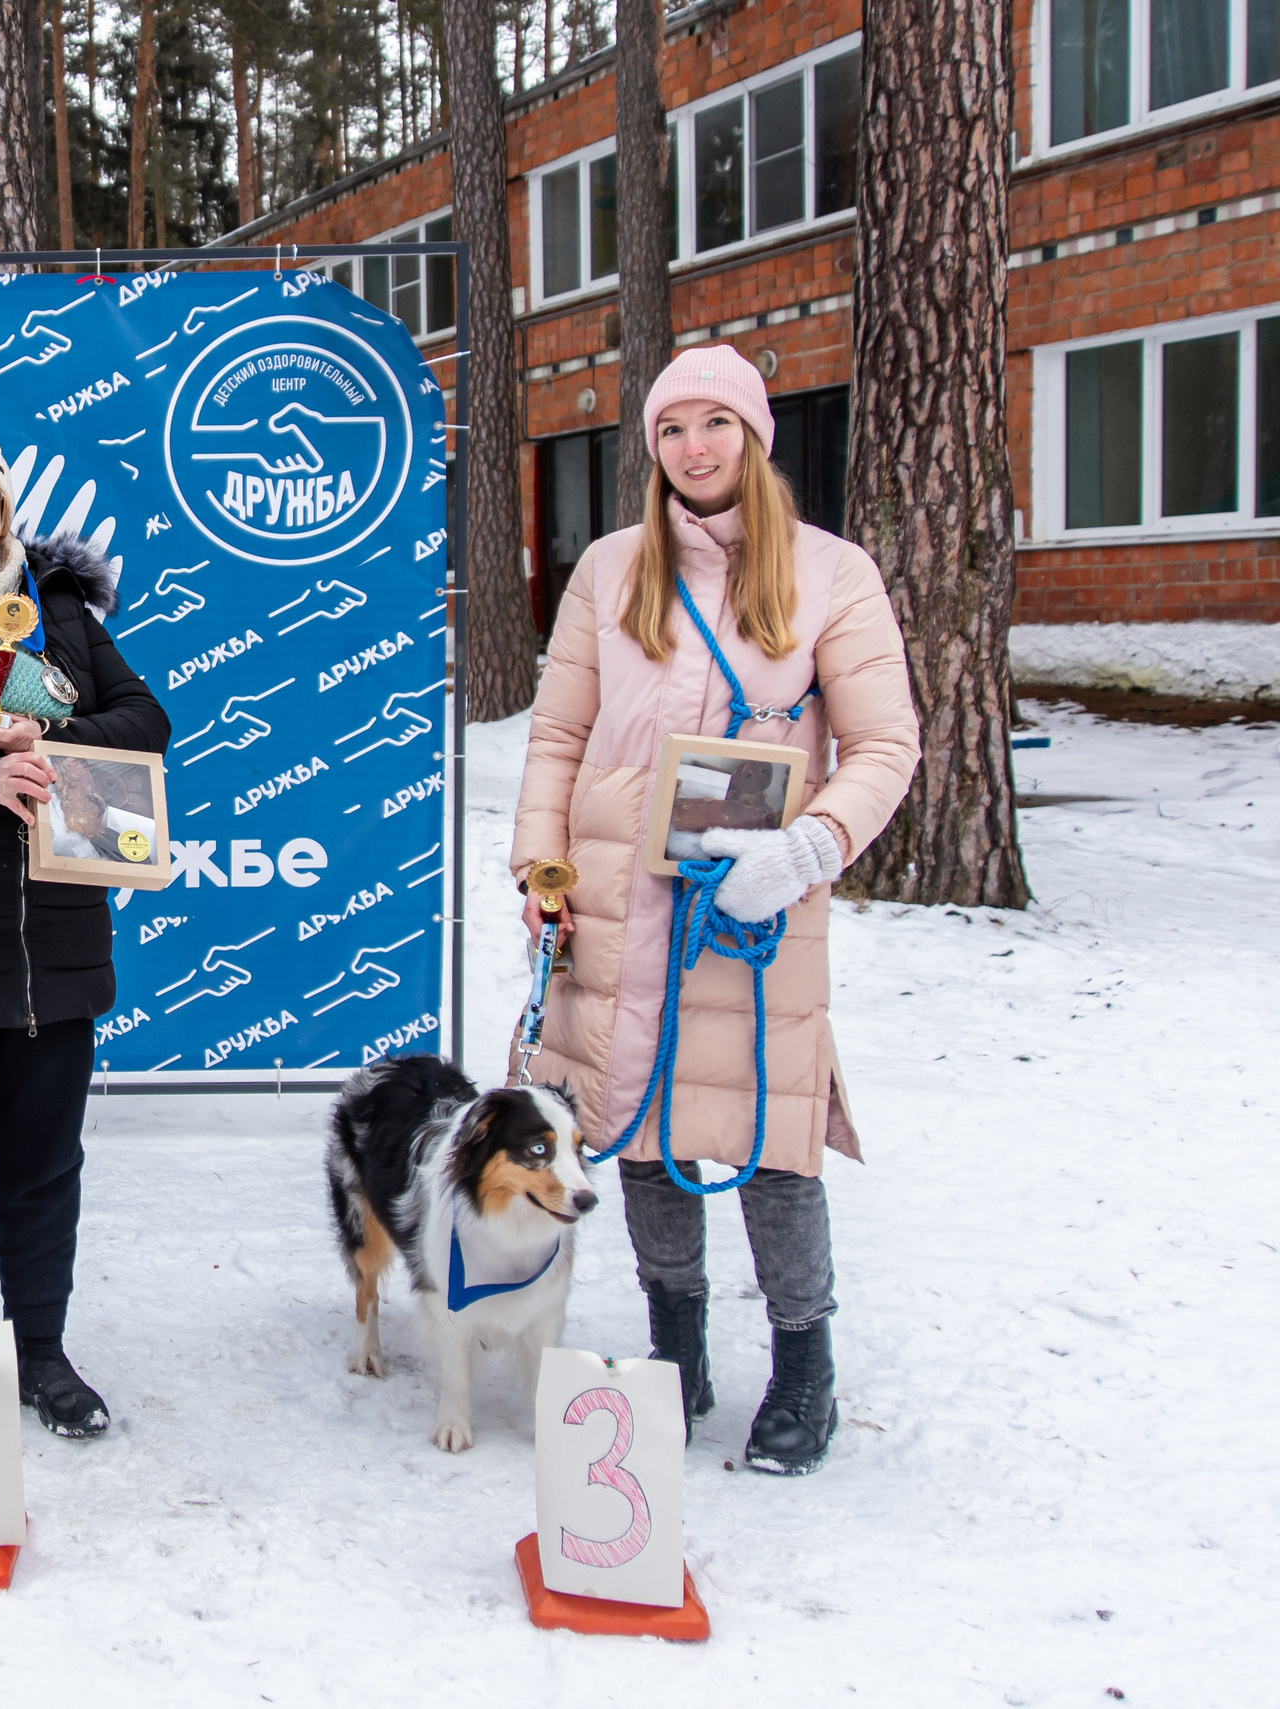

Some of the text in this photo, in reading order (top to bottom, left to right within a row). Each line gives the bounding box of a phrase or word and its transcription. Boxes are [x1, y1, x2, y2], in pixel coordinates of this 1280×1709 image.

[35, 371, 131, 423] РУЖБА
[213, 354, 366, 407] ДЕТСКИЙ ОЗДОРОВИТЕЛЬНЫЙ
[272, 377, 307, 393] ЦЕНТР
[223, 470, 356, 527] ДРУЖБА
[167, 629, 263, 691] ДРУЖБА
[318, 631, 414, 693] ДРУЖБА
[234, 756, 330, 816] ДРУЖБА
[382, 771, 445, 818] ДРУЖ
[204, 1009, 299, 1069] ДРУЖБА
[362, 1012, 439, 1066] ДРУЖБ
[561, 1387, 652, 1568] 3
